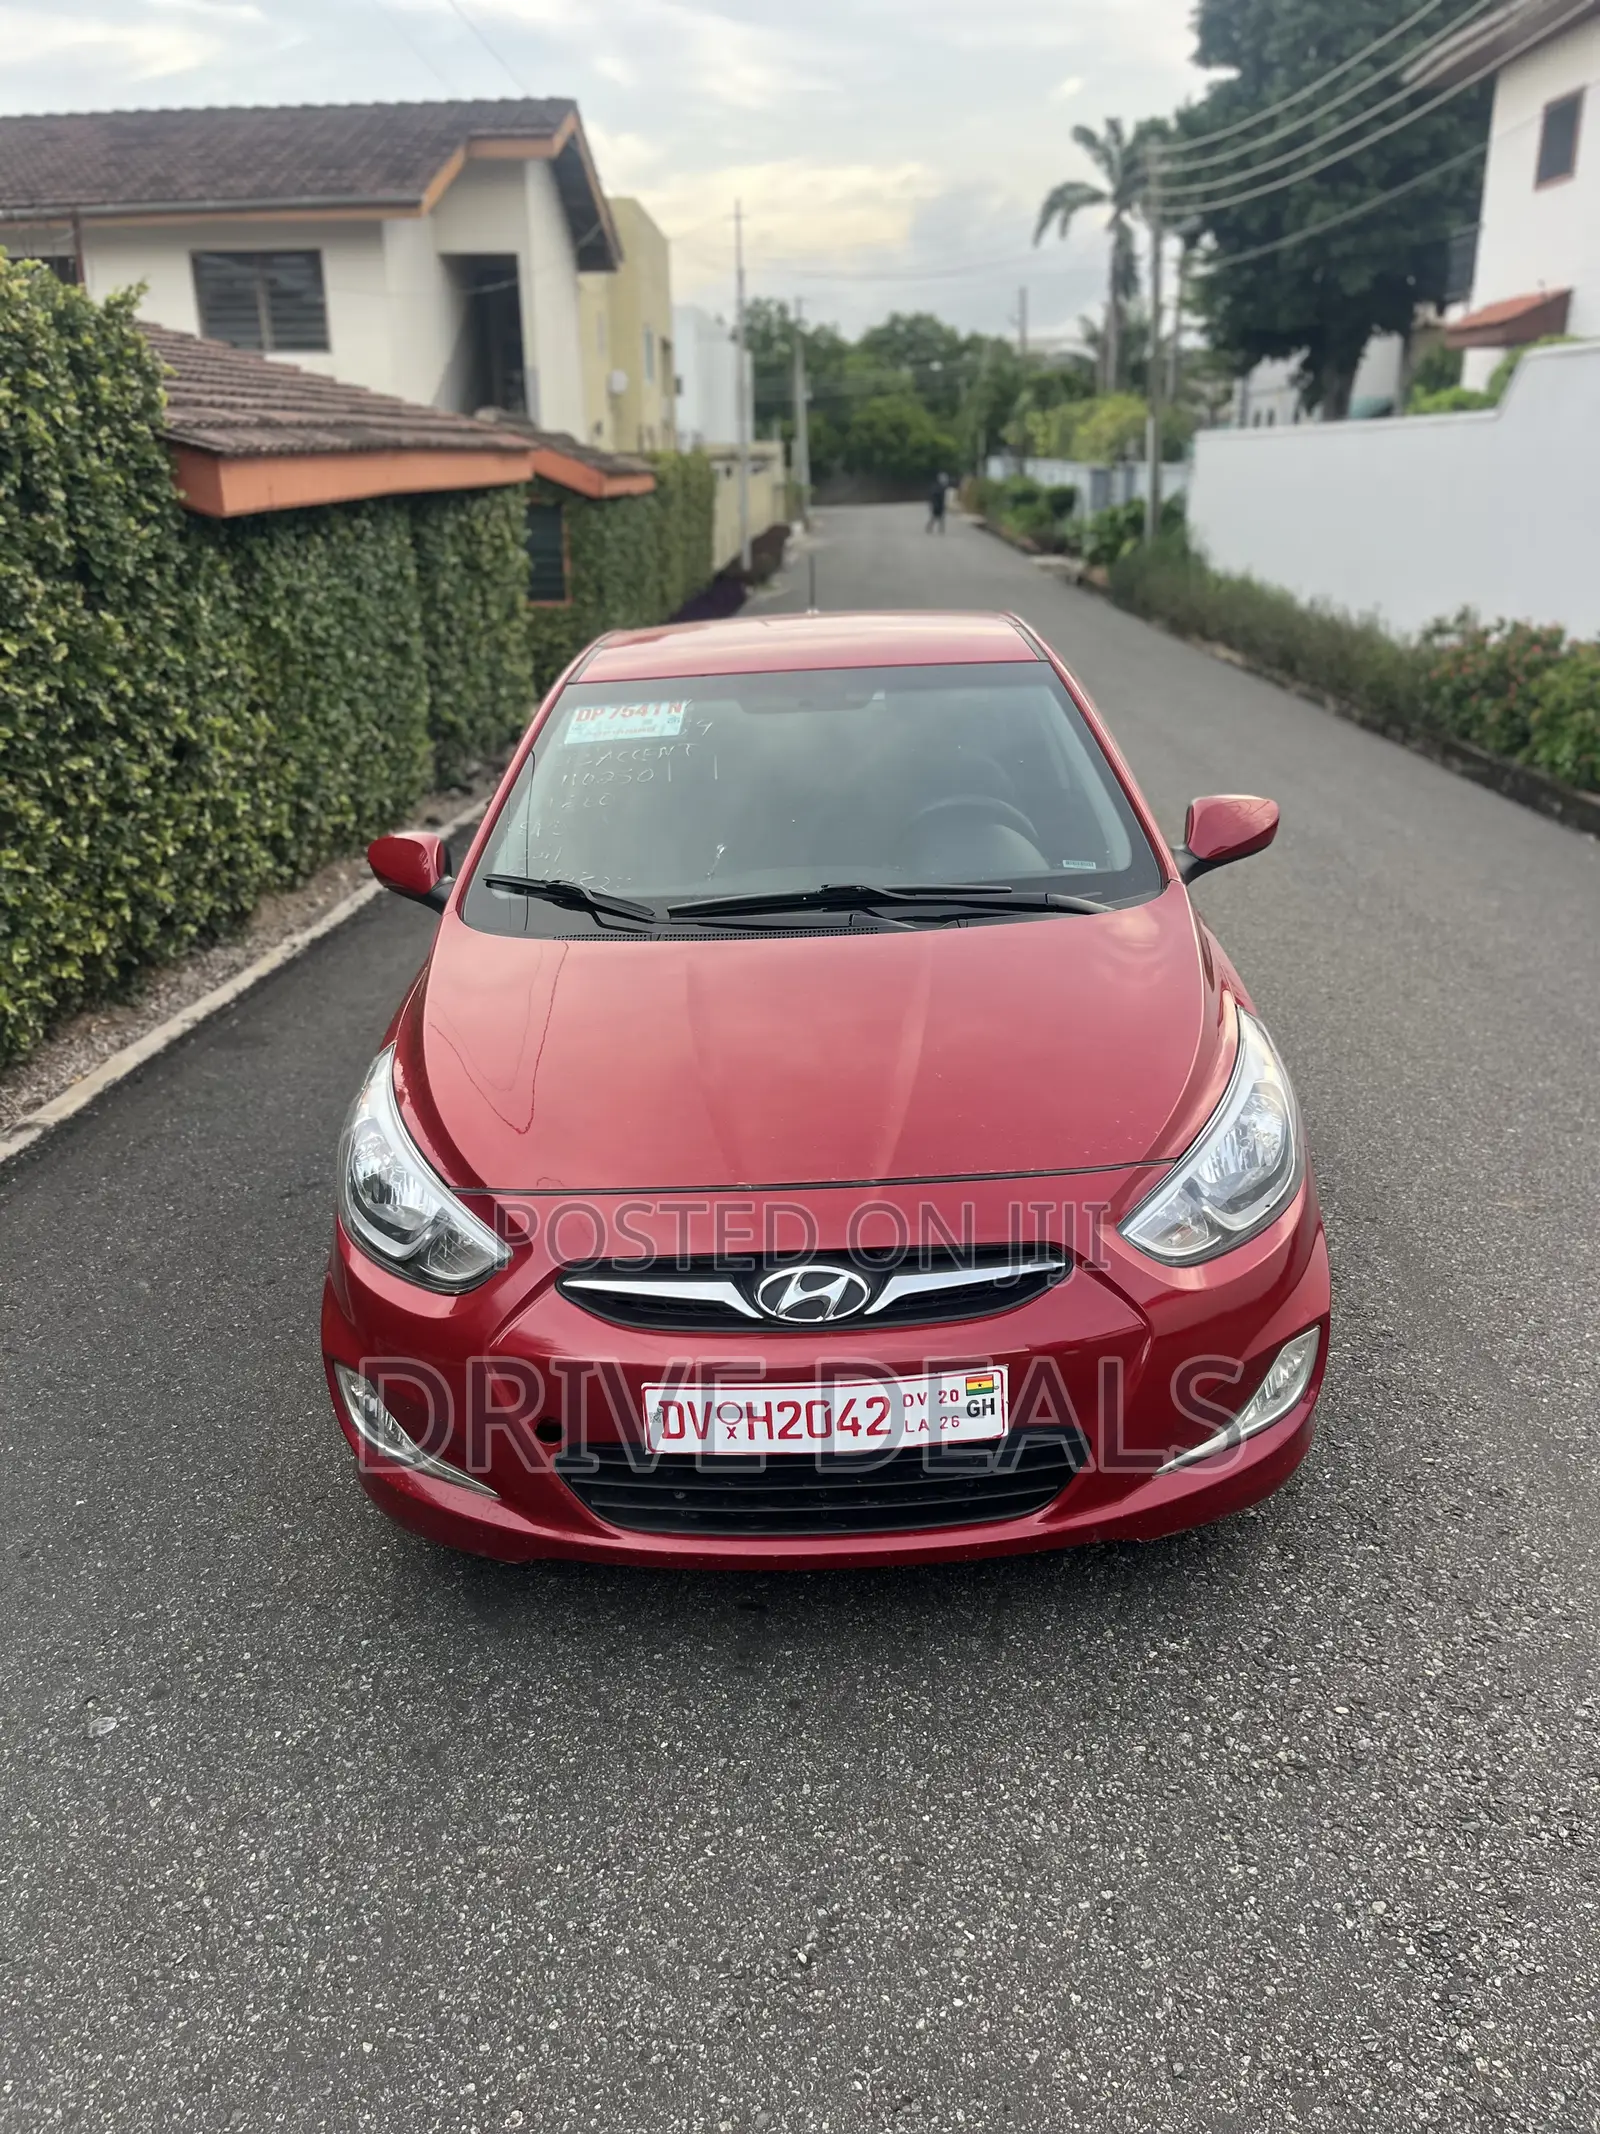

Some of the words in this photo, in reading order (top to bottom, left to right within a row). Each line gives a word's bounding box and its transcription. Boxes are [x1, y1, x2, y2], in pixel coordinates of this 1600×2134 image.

[576, 707, 605, 722] DP
[903, 1392, 928, 1408] DV
[938, 1389, 959, 1404] 20
[966, 1397, 995, 1418] GH
[904, 1417, 930, 1433] LA
[939, 1415, 960, 1430] 26
